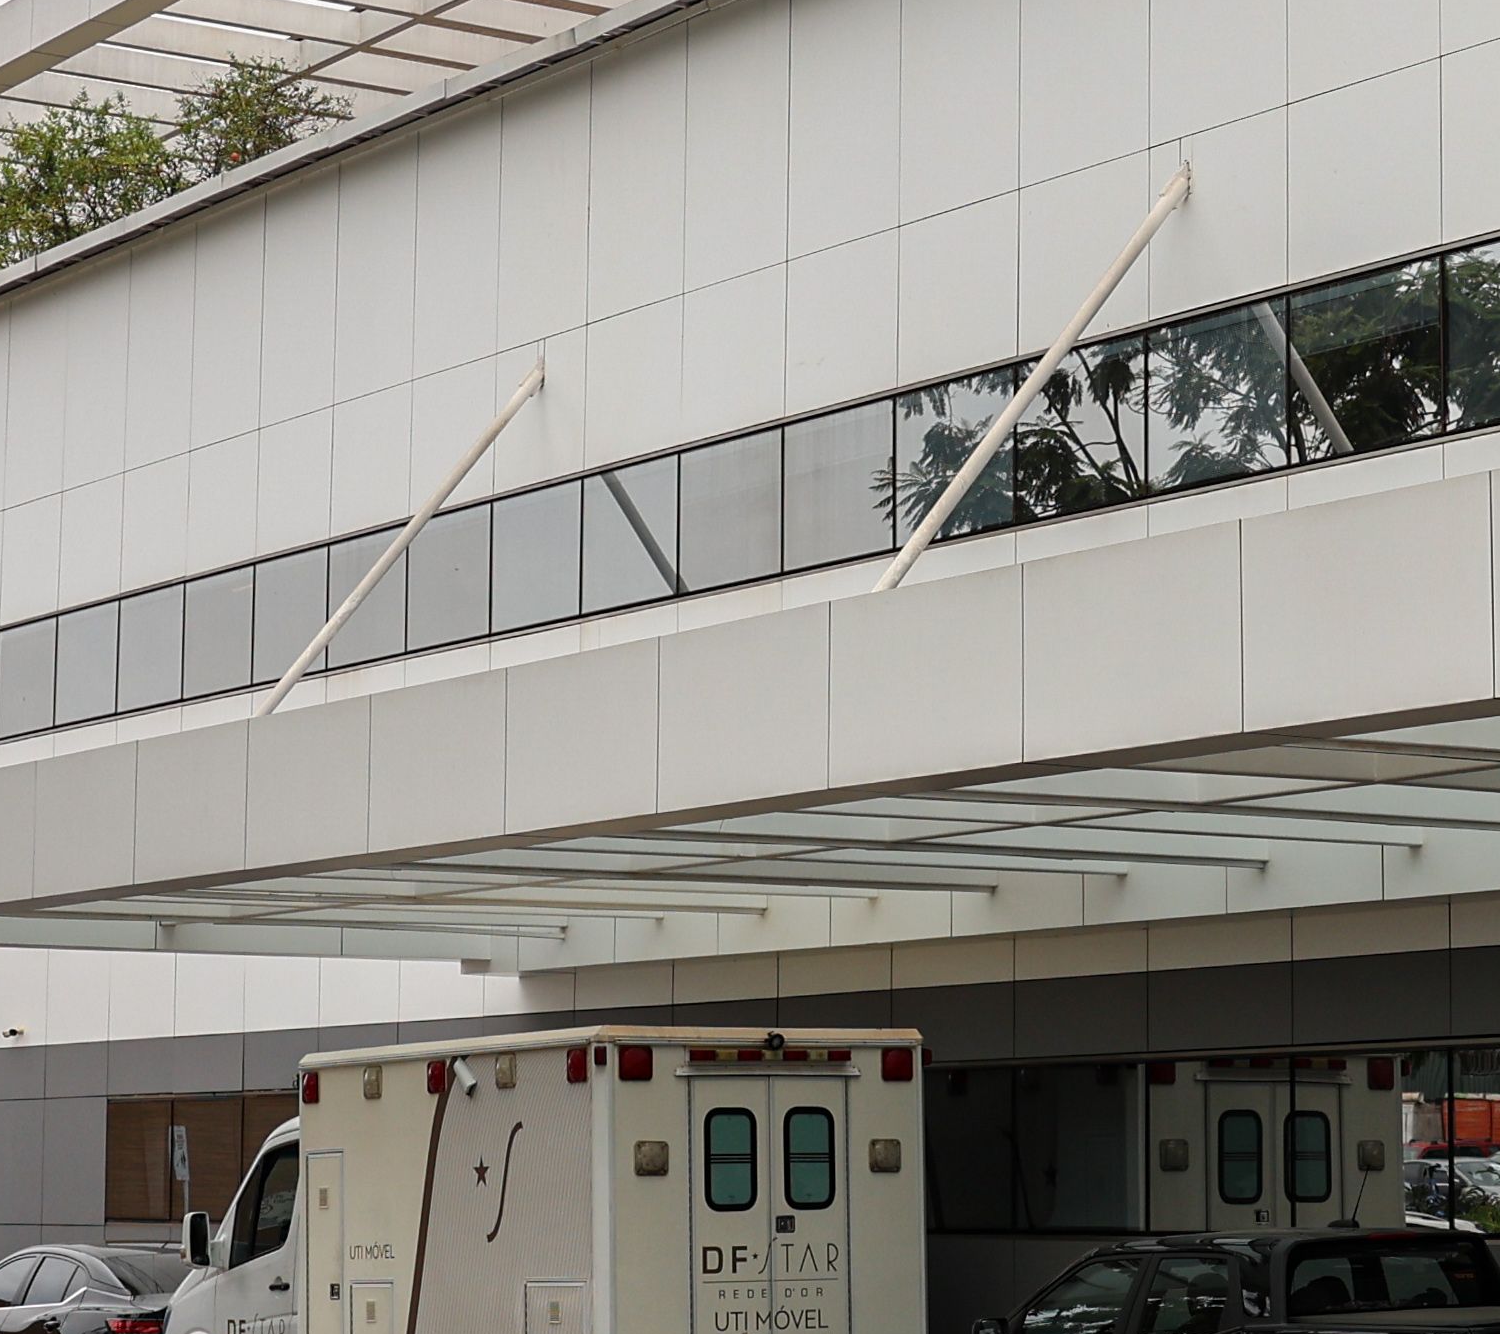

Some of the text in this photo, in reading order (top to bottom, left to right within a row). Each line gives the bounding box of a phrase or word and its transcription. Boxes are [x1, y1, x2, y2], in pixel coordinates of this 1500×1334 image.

[349, 1241, 395, 1260] UTI MÓVEL
[718, 1287, 824, 1300] REDE D'OR
[714, 1304, 829, 1332] UTI MÓVEL
